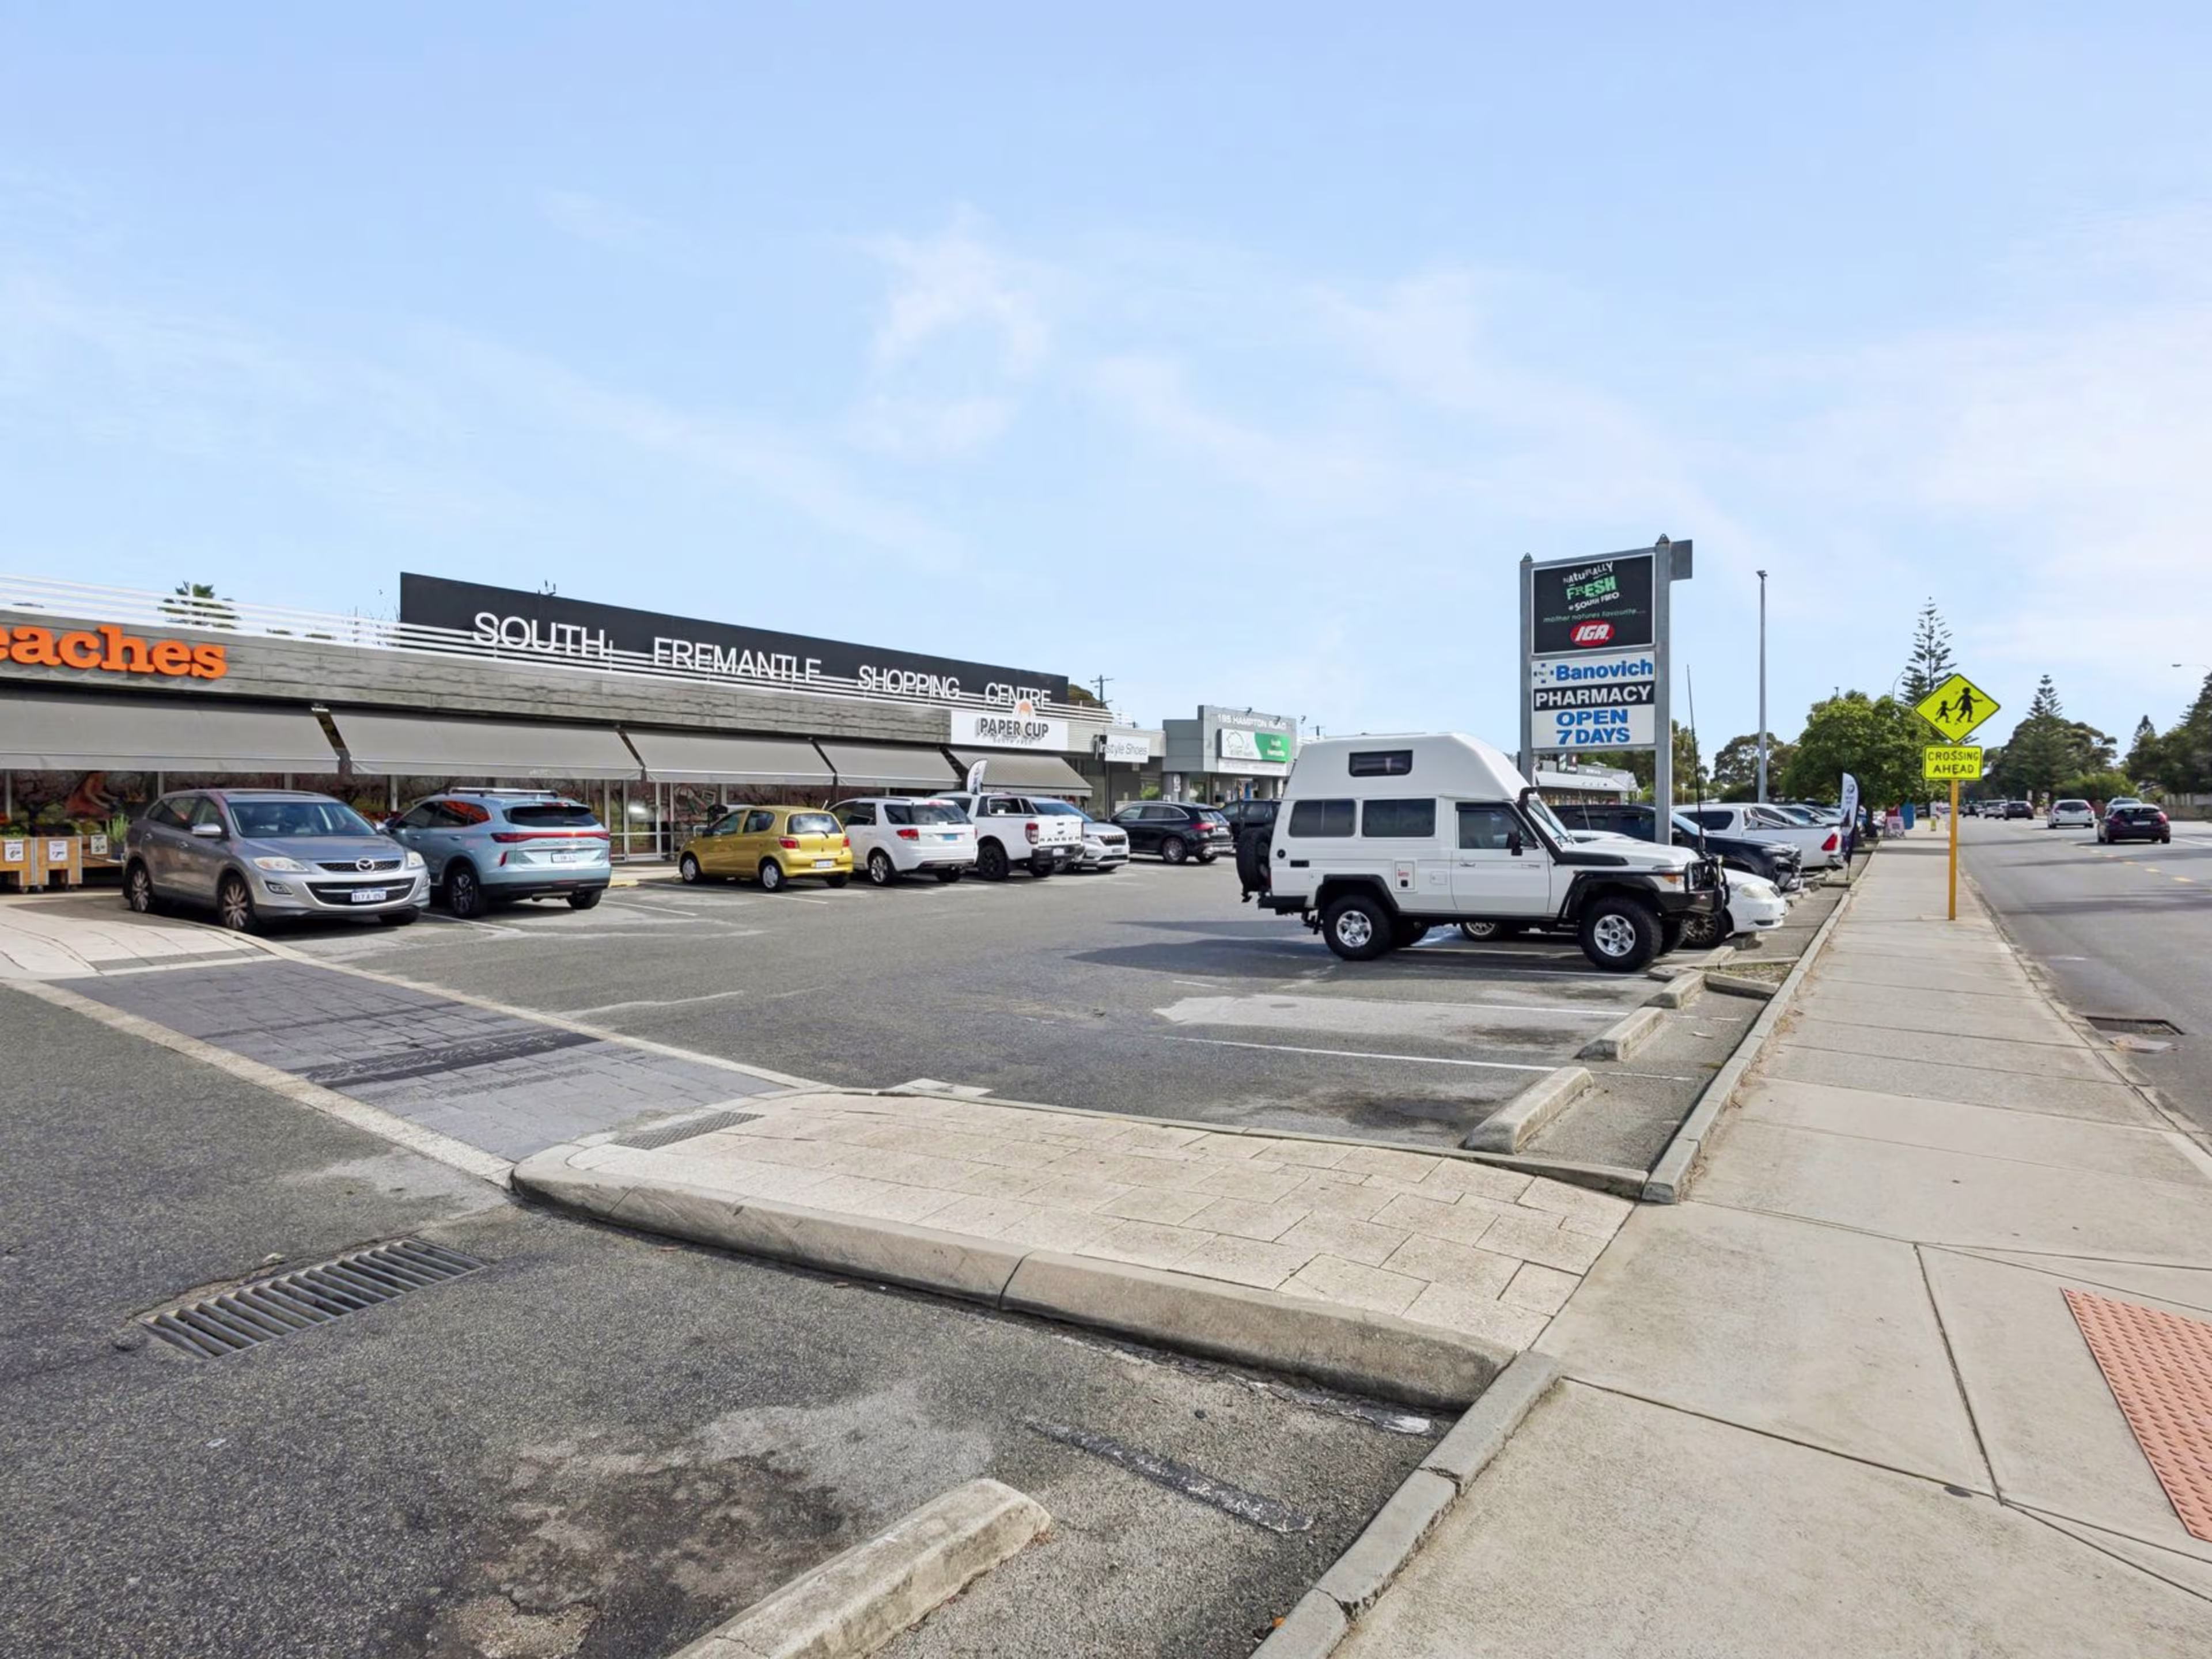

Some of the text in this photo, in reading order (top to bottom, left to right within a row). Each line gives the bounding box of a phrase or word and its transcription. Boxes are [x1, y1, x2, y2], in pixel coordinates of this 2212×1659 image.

[1566, 575, 1616, 600] FRESH
[1575, 624, 1609, 642] IGA
[0, 624, 228, 679] aches
[473, 612, 1052, 709] SOUTH FREMANTLE SHOPPING CENTRE
[1556, 659, 1653, 681] Banovich
[1535, 685, 1652, 707] PHARMACY
[1556, 709, 1628, 726] OPEN
[980, 718, 1049, 738] PAPER CUP
[1556, 727, 1630, 745] 7 DAYS
[1927, 751, 1979, 761] CROSSING
[1933, 764, 1974, 774] AHEAD
